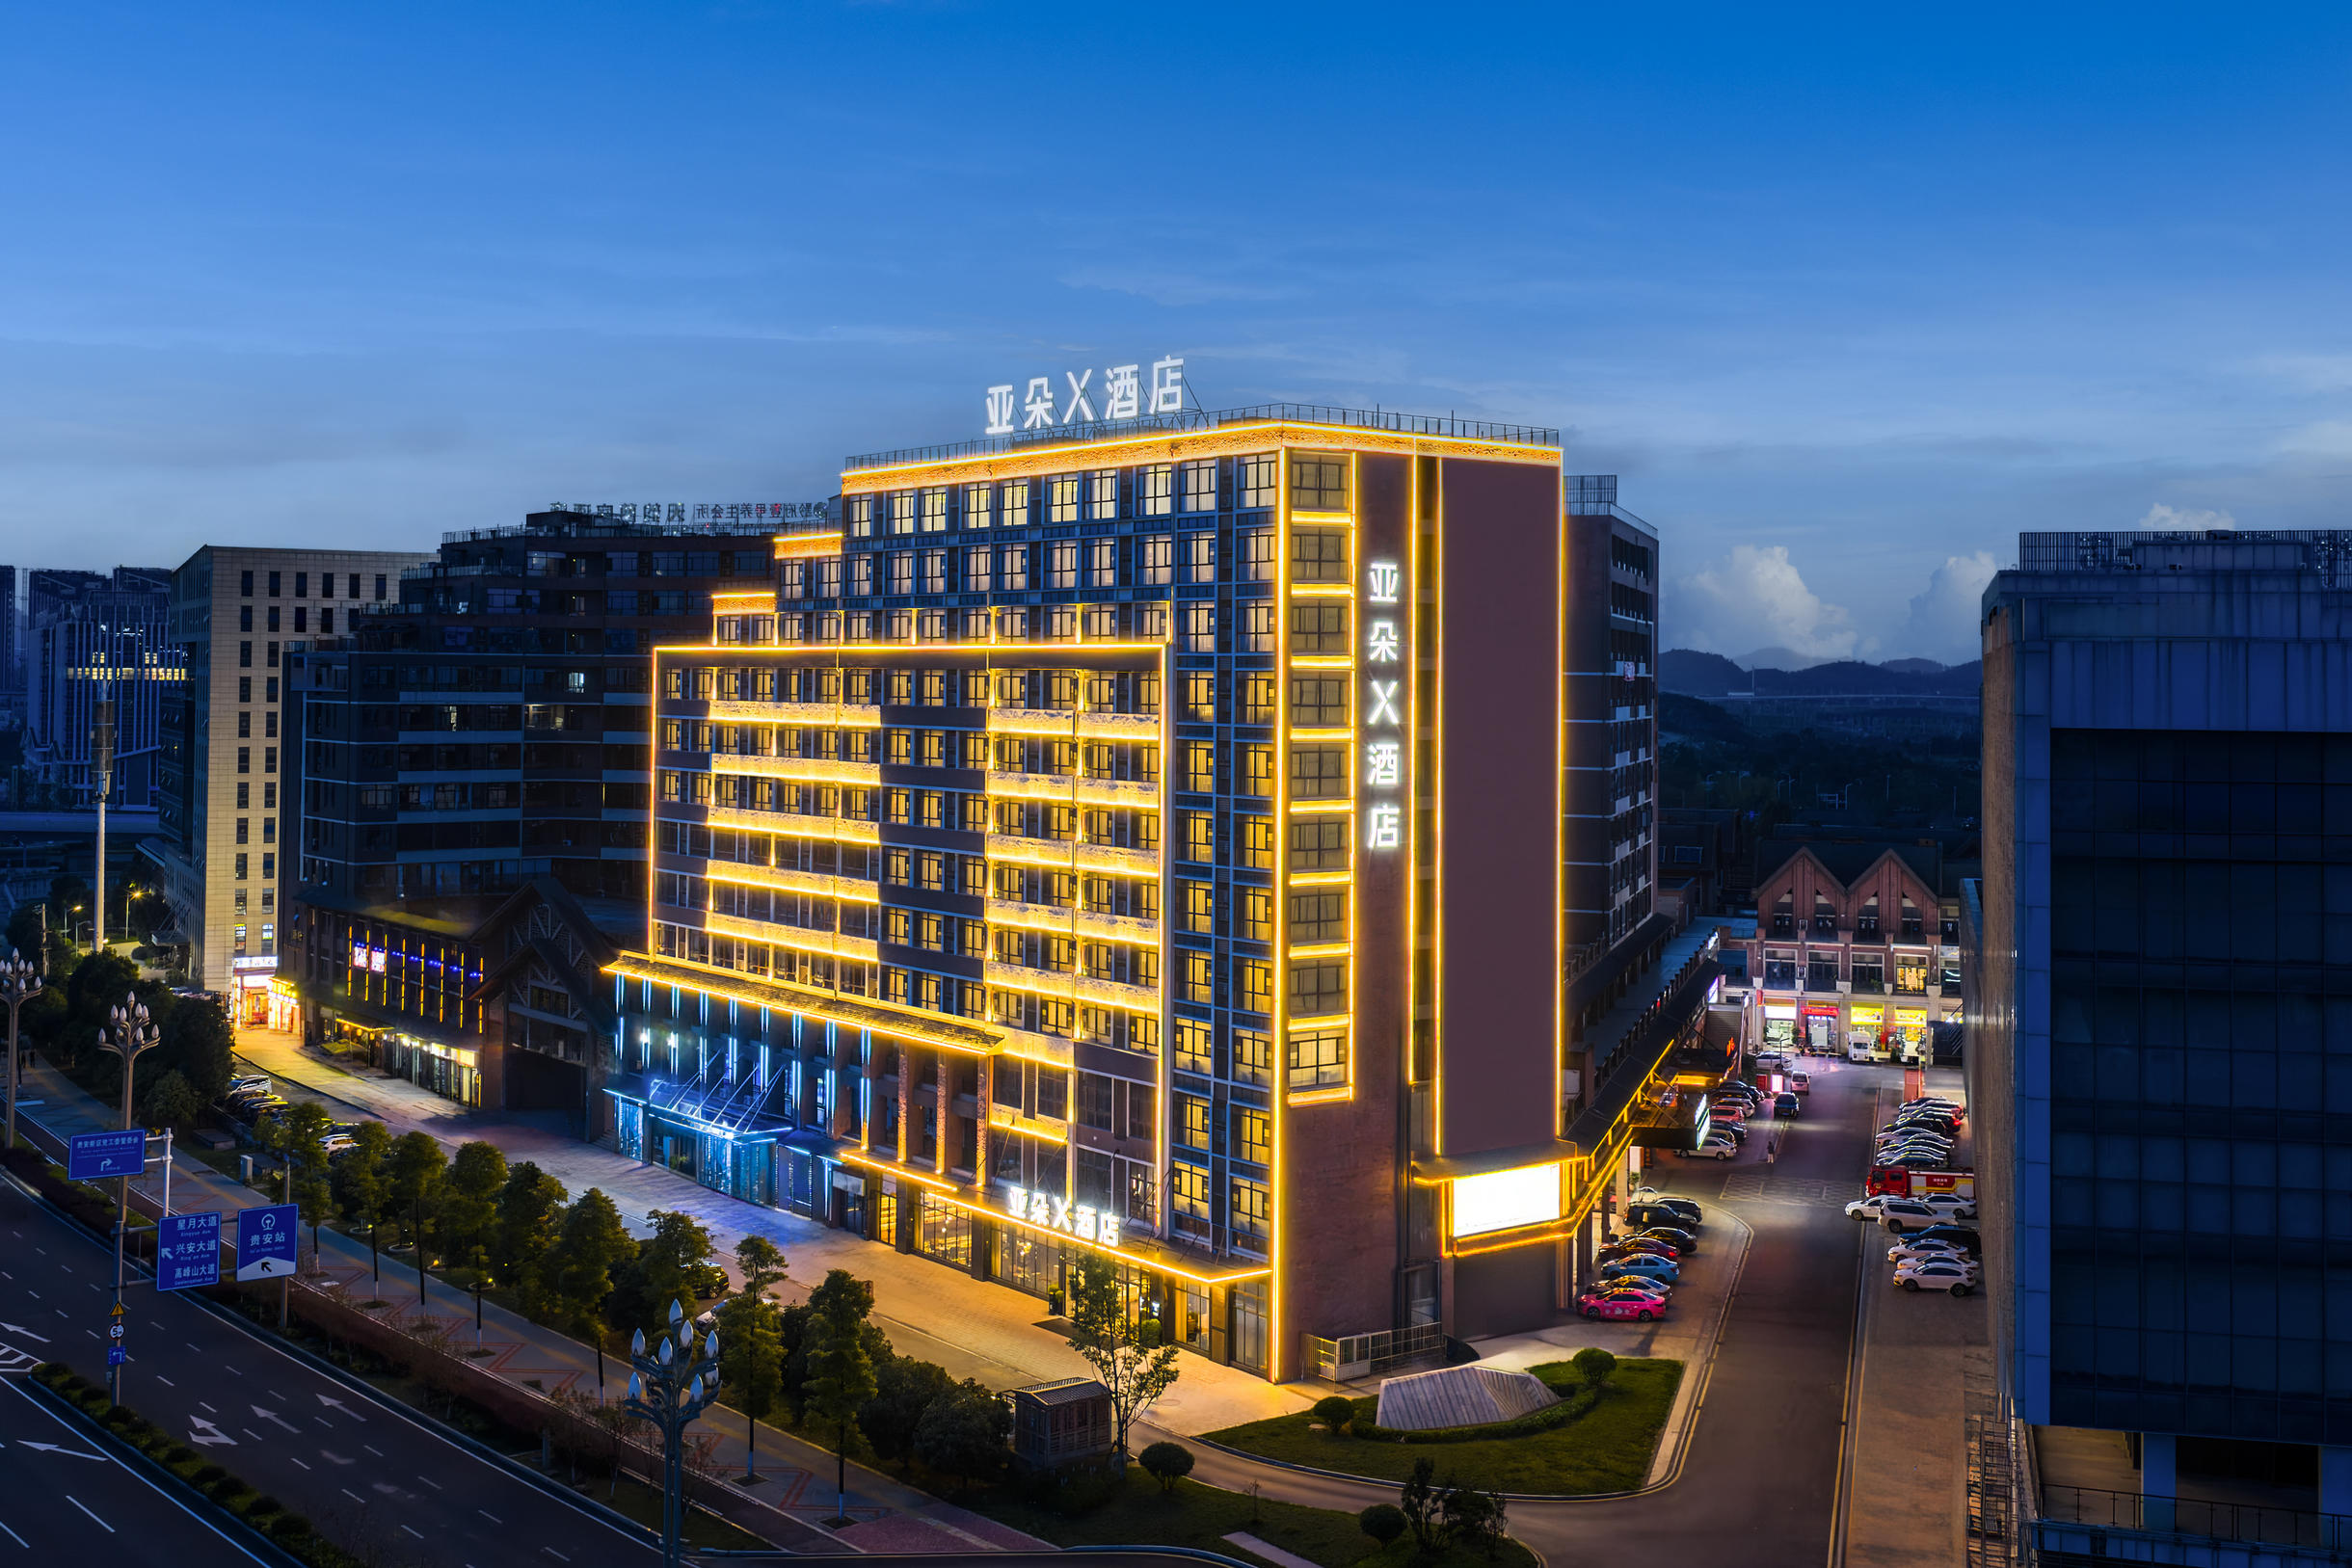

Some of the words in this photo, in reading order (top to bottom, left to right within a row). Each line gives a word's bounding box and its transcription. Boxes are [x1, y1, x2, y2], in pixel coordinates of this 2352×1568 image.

[985, 355, 1184, 434] 亚朵X酒店
[1368, 563, 1400, 849] 亚朵X酒店
[177, 1215, 217, 1231] 星月大道
[1008, 1186, 1120, 1247] 亚朵X酒店
[175, 1239, 216, 1255] 兴安大道
[250, 1232, 285, 1246] 贵安站
[174, 1263, 215, 1279] 高峰山大道
